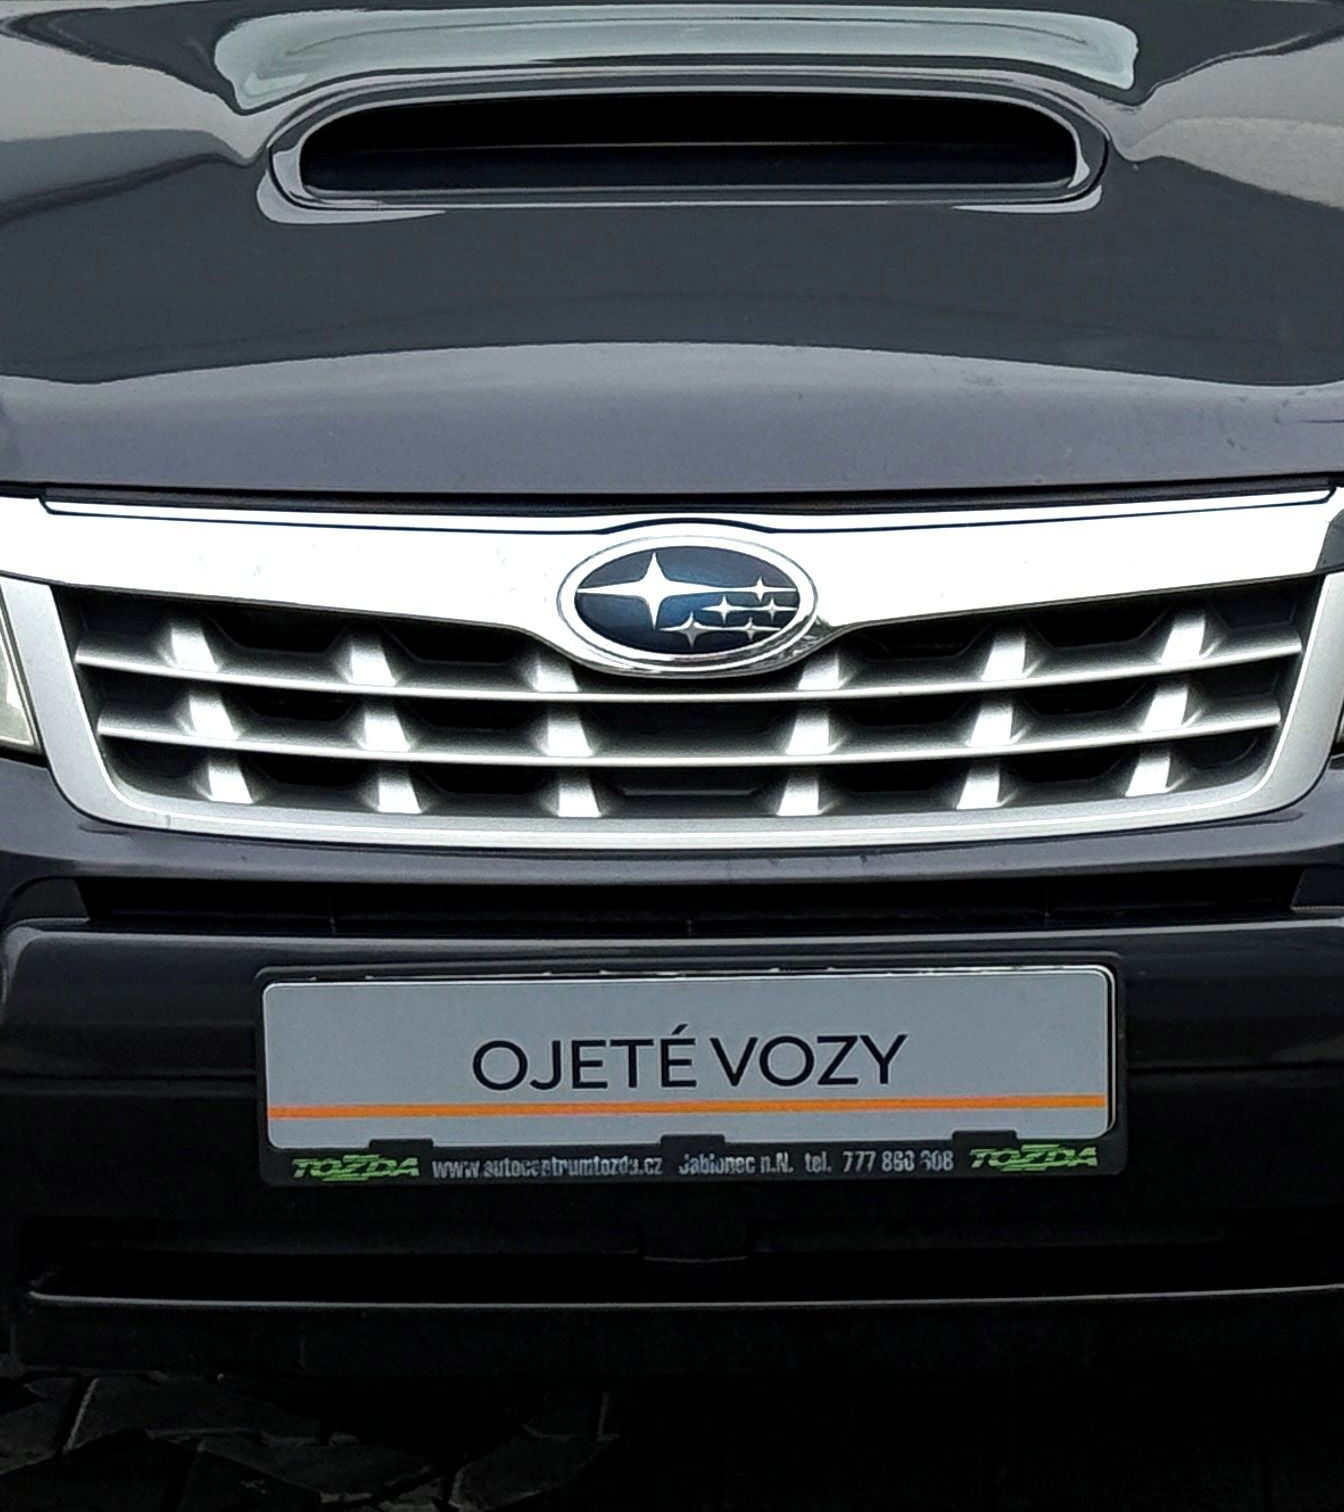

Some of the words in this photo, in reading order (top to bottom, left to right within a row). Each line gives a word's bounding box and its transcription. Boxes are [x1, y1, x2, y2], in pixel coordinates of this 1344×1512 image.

[471, 1023, 698, 1091] OJETÉ
[709, 1033, 909, 1087] VOZY
[804, 1150, 832, 1173] tel.
[842, 1150, 877, 1173] 777
